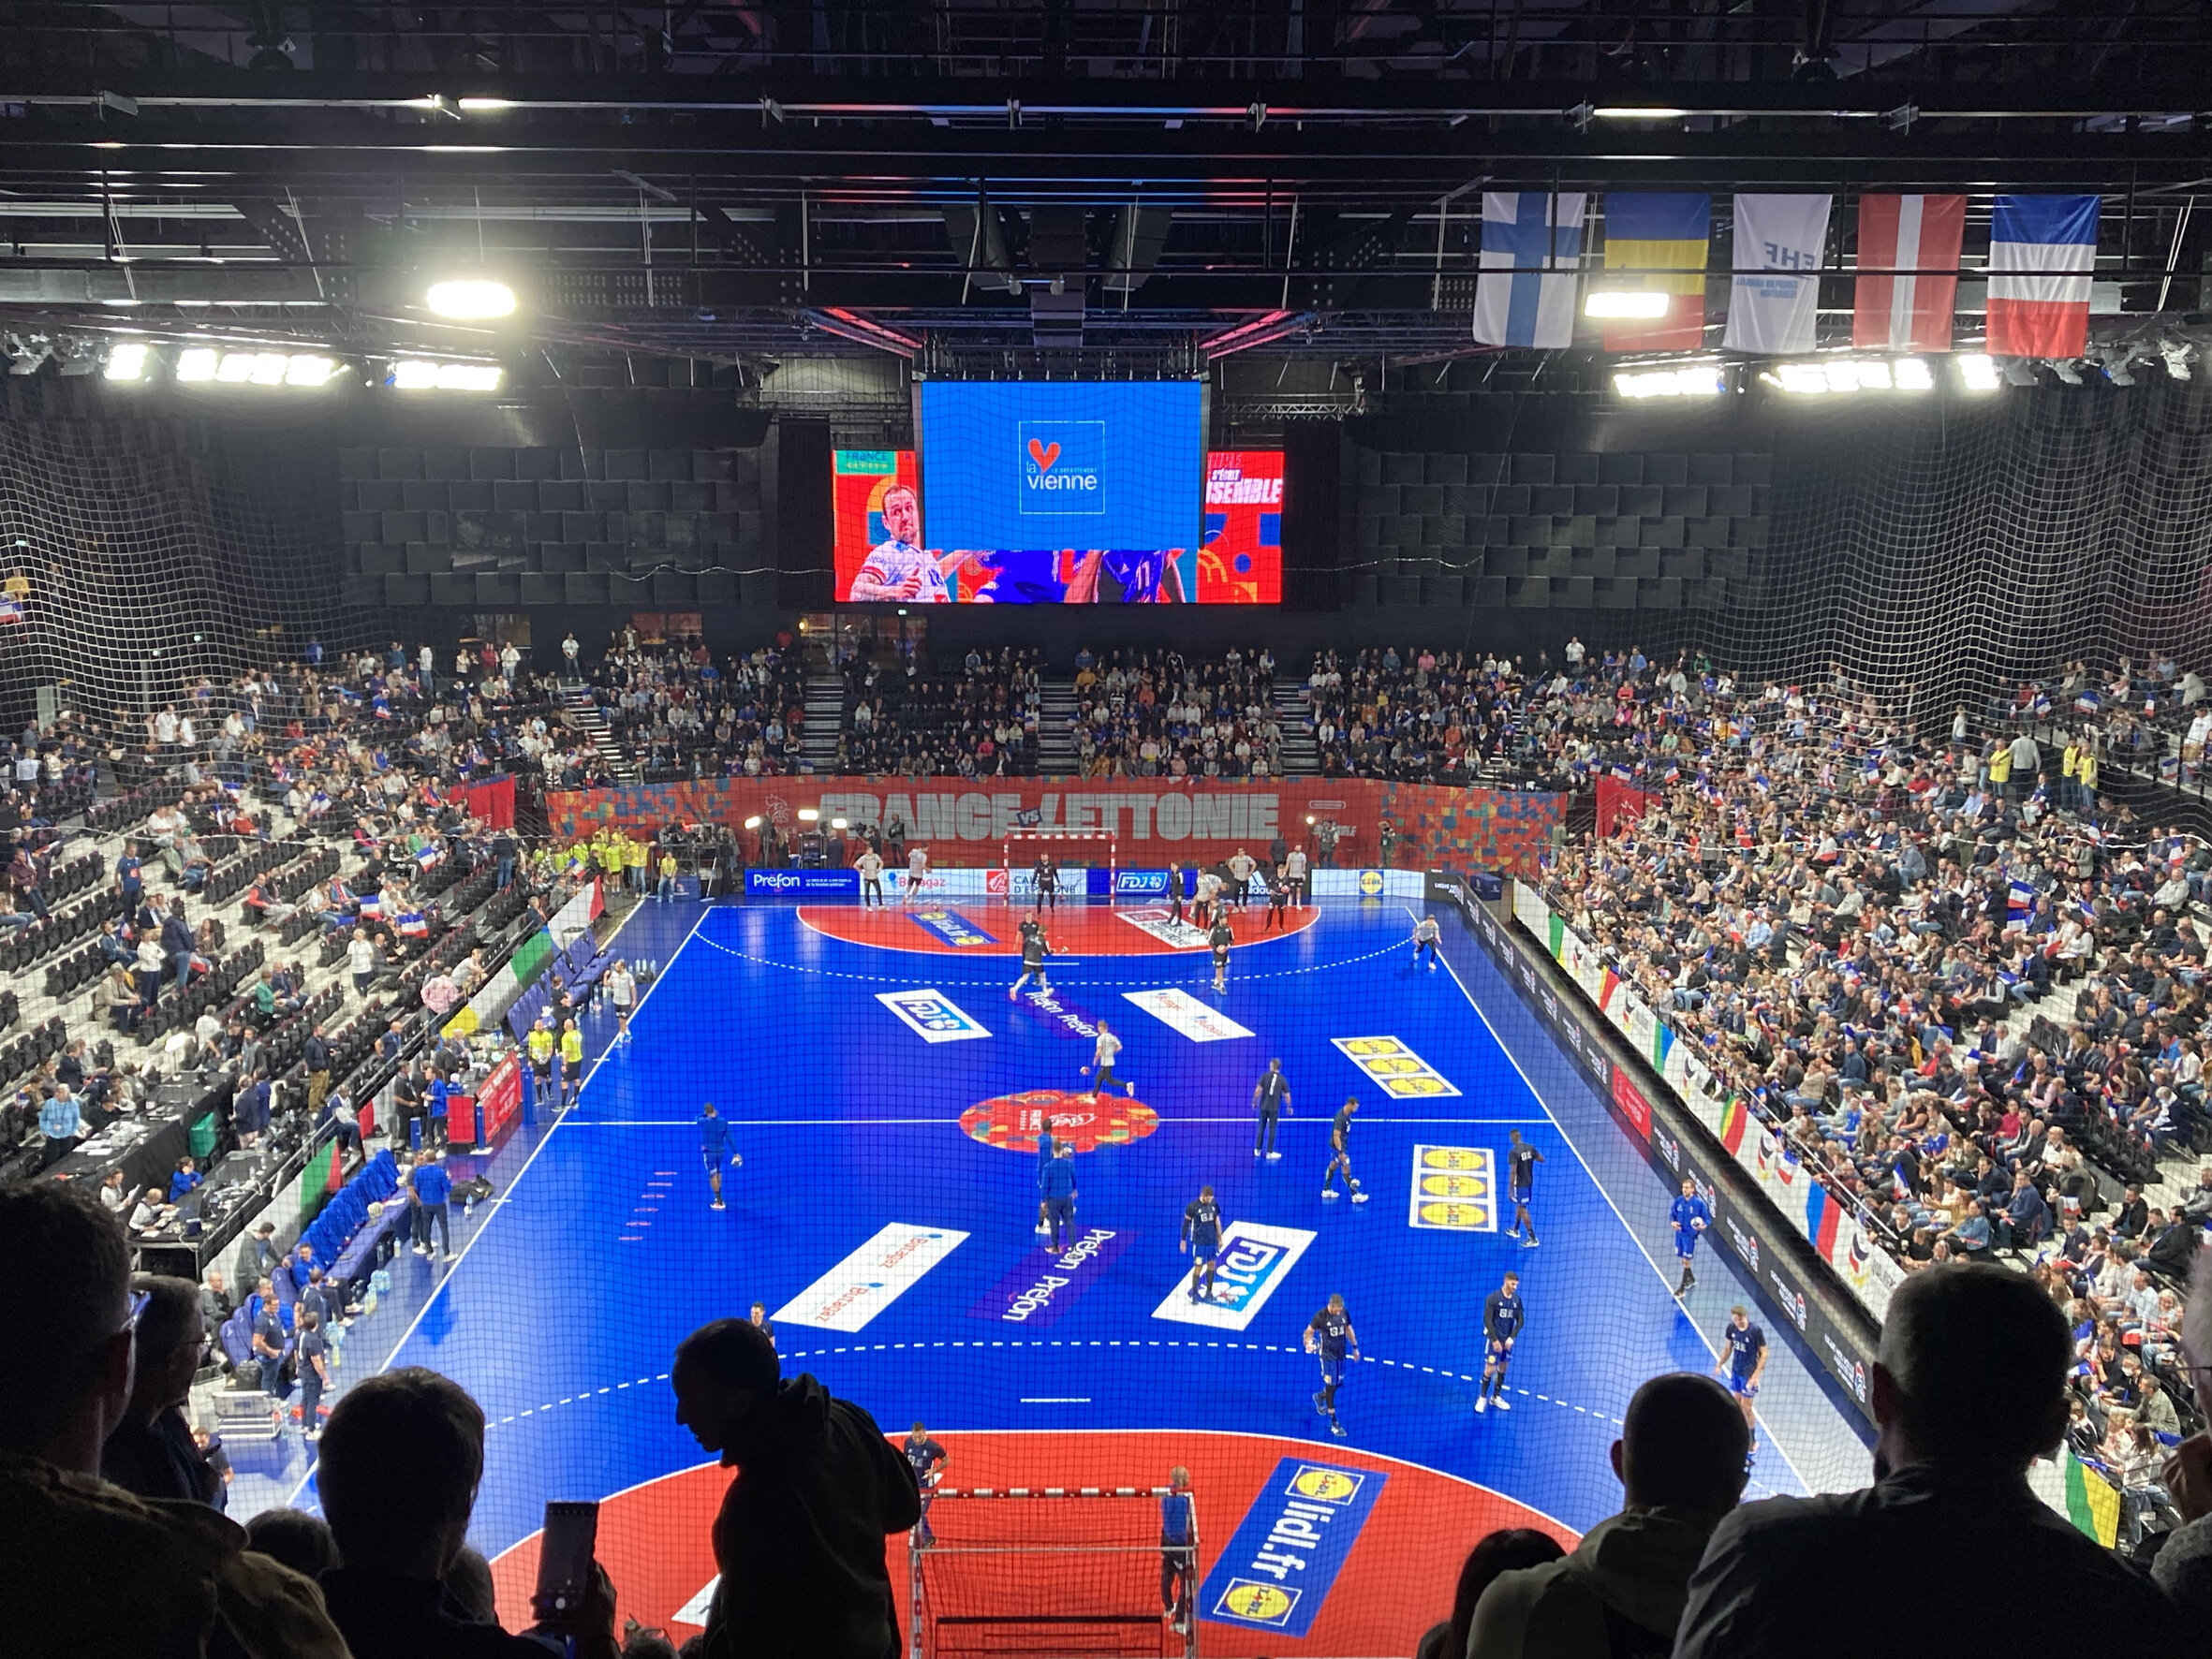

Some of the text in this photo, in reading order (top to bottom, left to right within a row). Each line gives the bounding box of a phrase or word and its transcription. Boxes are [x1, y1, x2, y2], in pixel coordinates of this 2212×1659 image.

[1026, 461, 1037, 474] la
[1026, 475, 1098, 490] vienne
[818, 792, 1279, 840] FRANCE VS LETTONIE
[899, 876, 946, 889] Bagaz
[1120, 875, 1147, 888] FDJ
[1217, 1241, 1279, 1285] FDJ
[1251, 1500, 1335, 1580] lidl.fr
